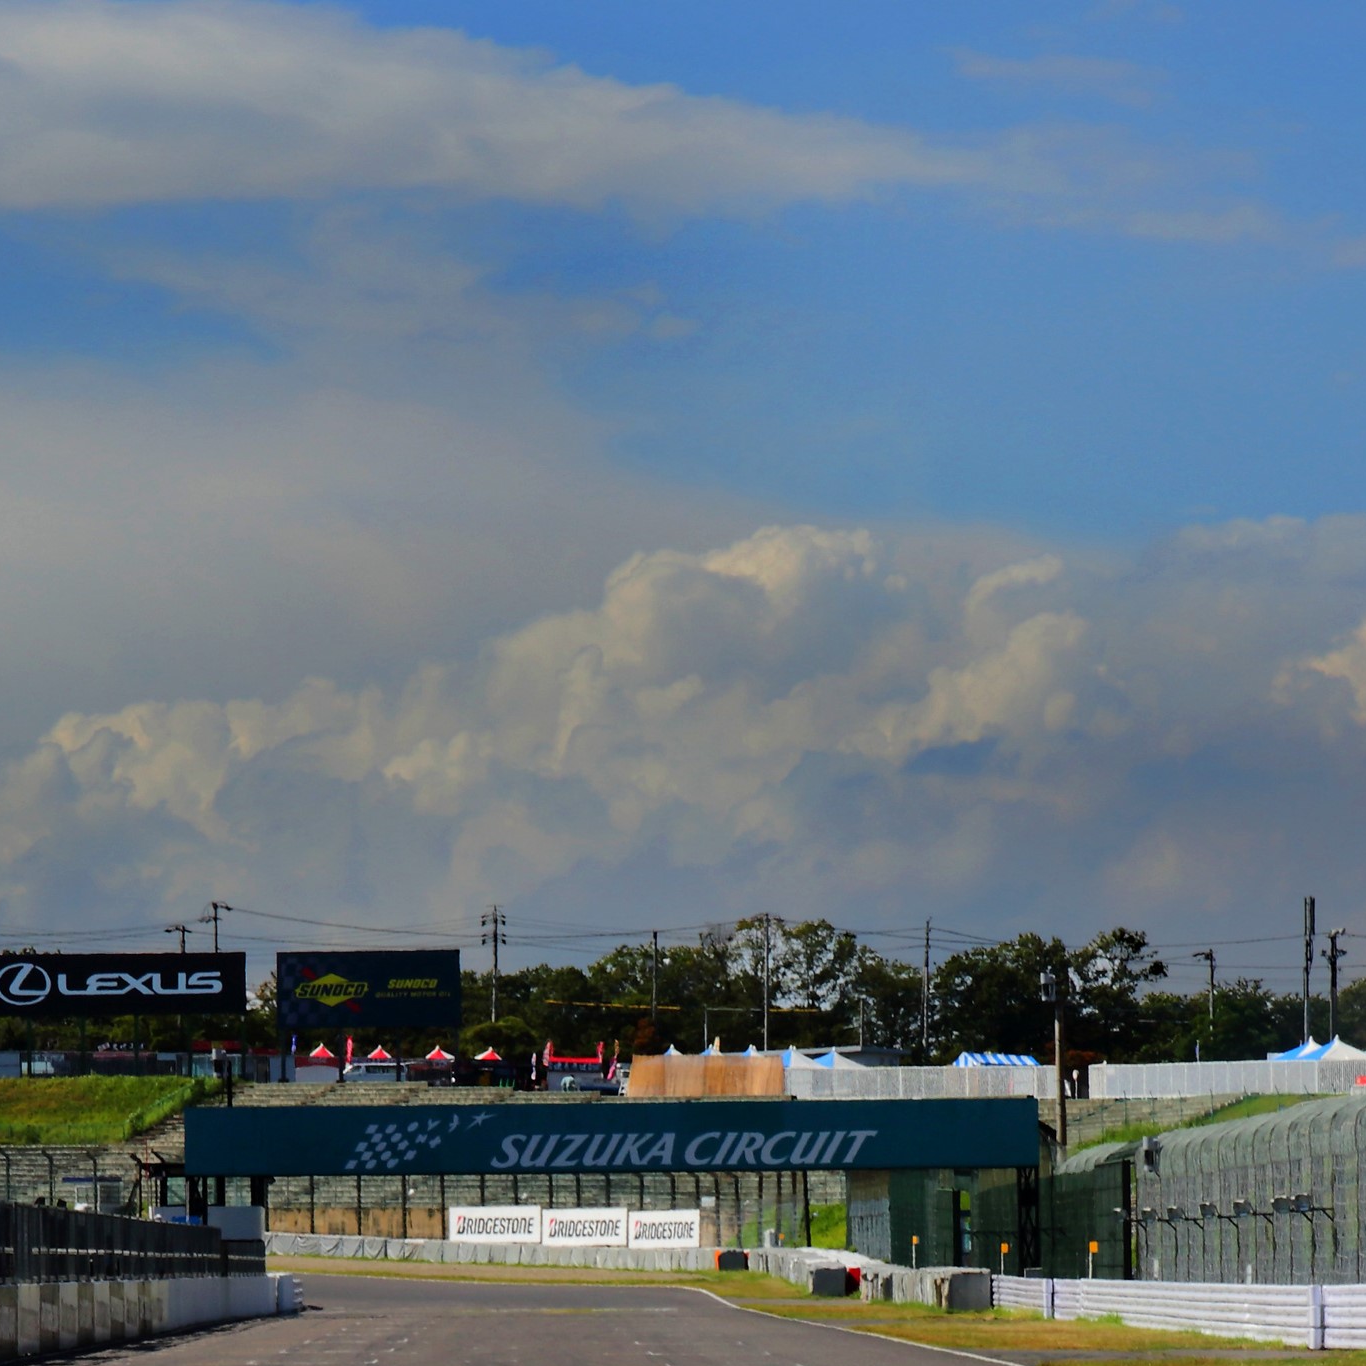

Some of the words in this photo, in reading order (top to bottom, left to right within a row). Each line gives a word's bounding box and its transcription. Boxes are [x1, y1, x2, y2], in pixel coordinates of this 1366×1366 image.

[57, 971, 224, 996] LEXUS
[296, 983, 367, 998] SUNOCO
[387, 978, 438, 990] SUNOCO
[490, 1131, 676, 1169] SUZUKA
[684, 1130, 878, 1167] CIRCUIT
[456, 1216, 535, 1235] BRIDGESTONE
[548, 1218, 621, 1238] BRIDGESTONE
[634, 1220, 695, 1240] BRIDGESTONE
